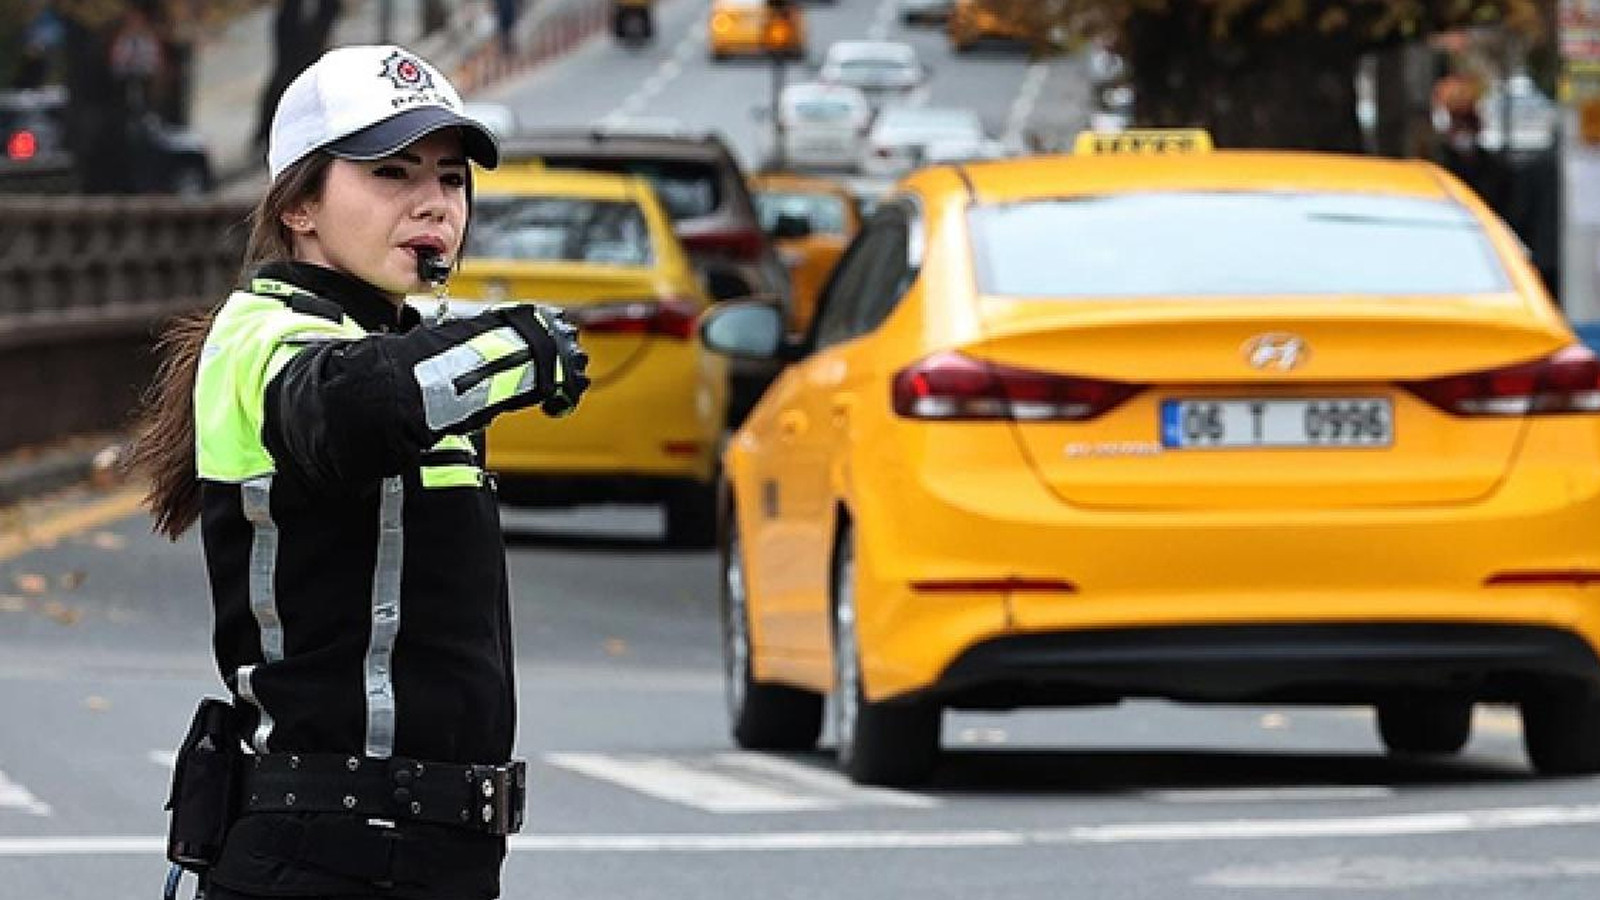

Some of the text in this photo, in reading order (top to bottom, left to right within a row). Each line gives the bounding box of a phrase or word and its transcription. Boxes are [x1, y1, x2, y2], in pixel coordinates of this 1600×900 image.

[1186, 401, 1224, 440] 06
[1249, 401, 1265, 441] T
[1306, 400, 1387, 440] 0996
